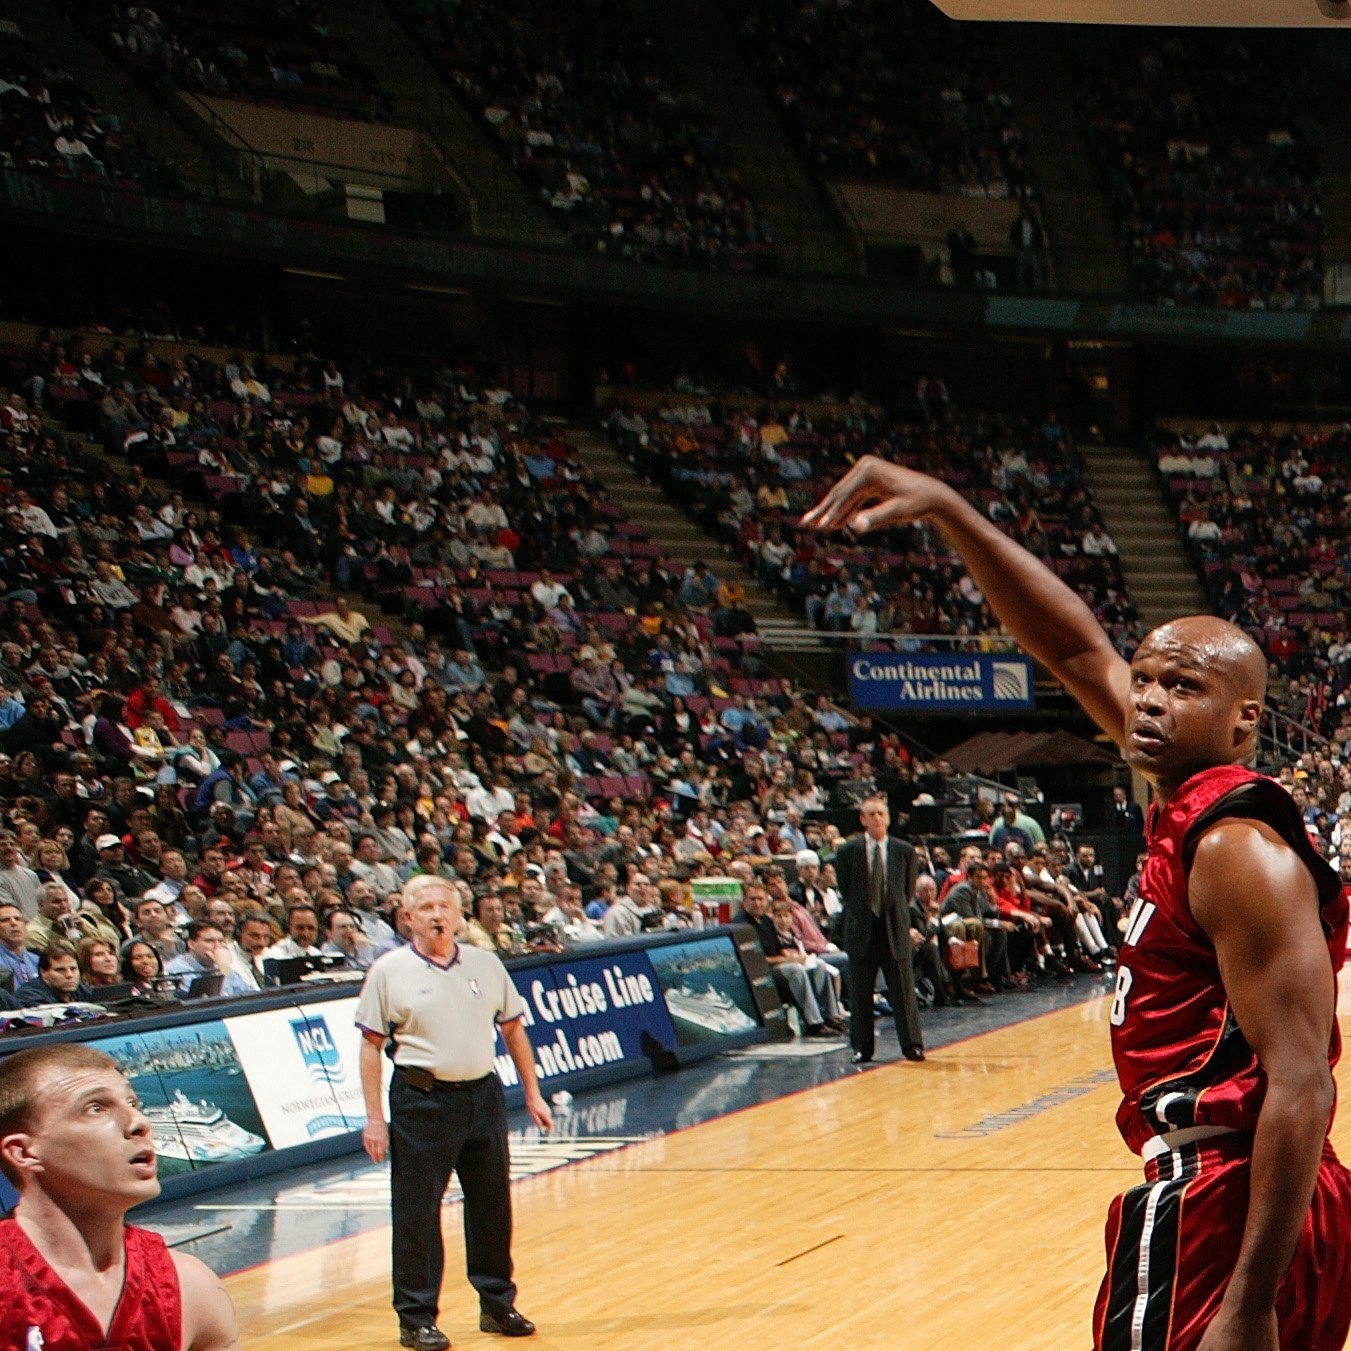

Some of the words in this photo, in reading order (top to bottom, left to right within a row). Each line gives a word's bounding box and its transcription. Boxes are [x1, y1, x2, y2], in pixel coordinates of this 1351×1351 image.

[853, 659, 981, 681] Continental
[900, 681, 983, 700] Airlines
[531, 973, 607, 1023] Cruise
[602, 964, 654, 1009] Line
[1110, 965, 1132, 1026] 8
[297, 1026, 335, 1056] NCL
